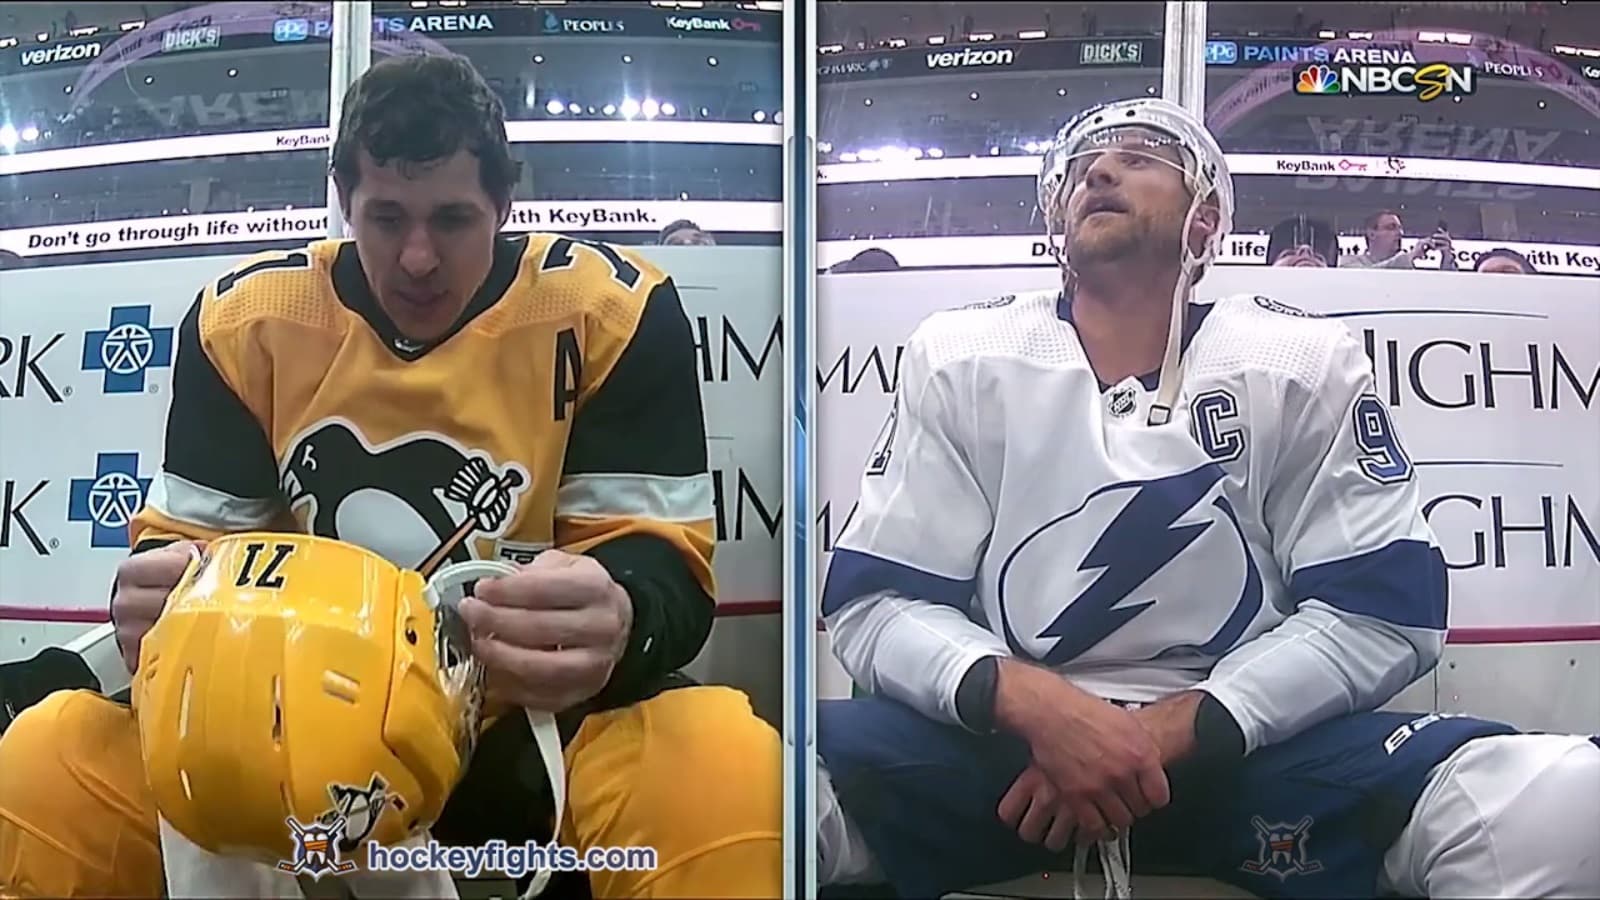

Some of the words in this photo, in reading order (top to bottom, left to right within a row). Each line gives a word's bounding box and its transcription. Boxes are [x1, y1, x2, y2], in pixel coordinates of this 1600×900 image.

[409, 14, 494, 32] ARENA
[667, 16, 731, 31] KeyBank
[165, 28, 217, 48] DICK'S
[21, 42, 101, 66] verizon
[926, 48, 1014, 68] verizon
[1083, 43, 1140, 60] DICK'S
[1244, 46, 1329, 62] PAINTS
[1333, 49, 1417, 64] ARENA
[1276, 159, 1336, 173] KeyBank
[28, 231, 80, 249] Don't
[86, 232, 111, 248] go
[118, 223, 200, 242] through
[206, 220, 239, 236] life
[512, 209, 540, 223] ith
[549, 208, 657, 227] KeyBank.
[1232, 241, 1265, 256] life
[553, 326, 583, 422] A
[1191, 389, 1245, 463] C
